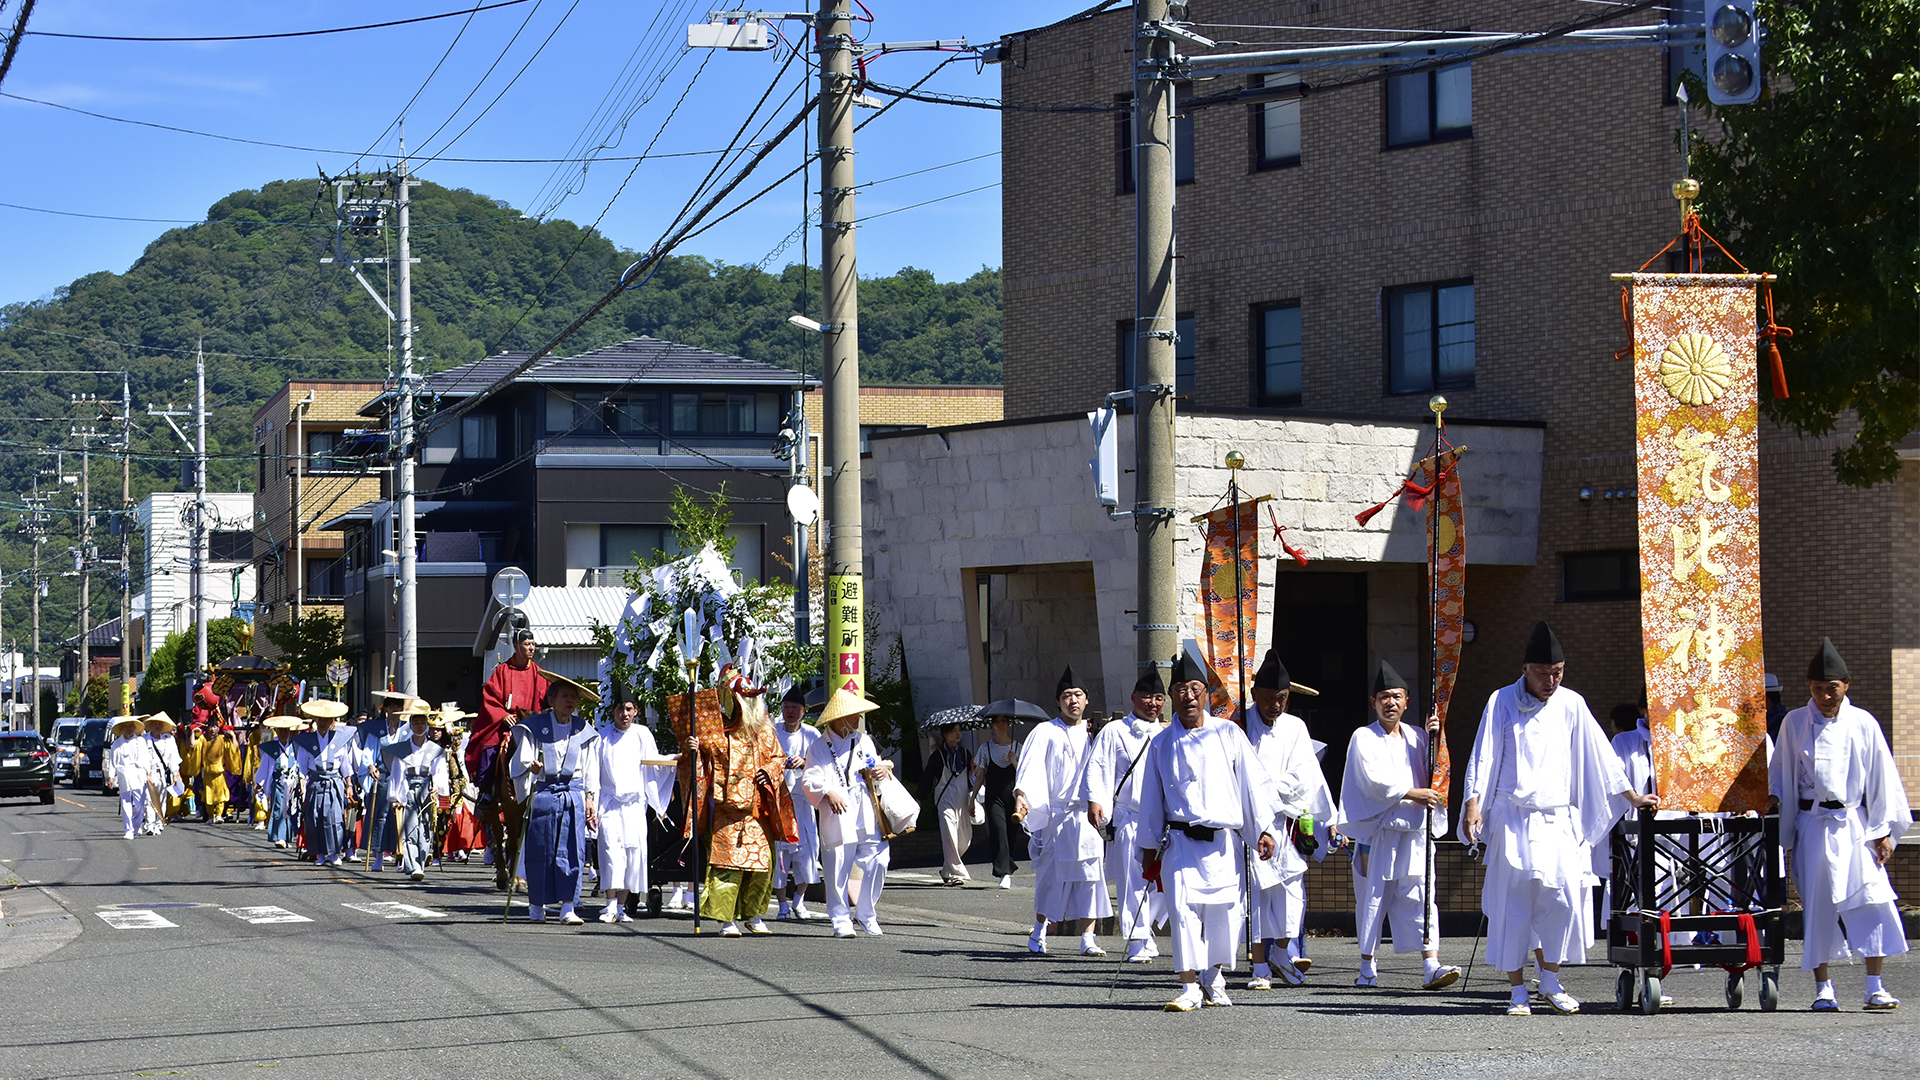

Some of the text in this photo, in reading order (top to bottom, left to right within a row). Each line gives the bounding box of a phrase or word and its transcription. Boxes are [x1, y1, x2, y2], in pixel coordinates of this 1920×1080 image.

[841, 582, 858, 647] 避難所
[1665, 429, 1739, 767] 氣比神宮
